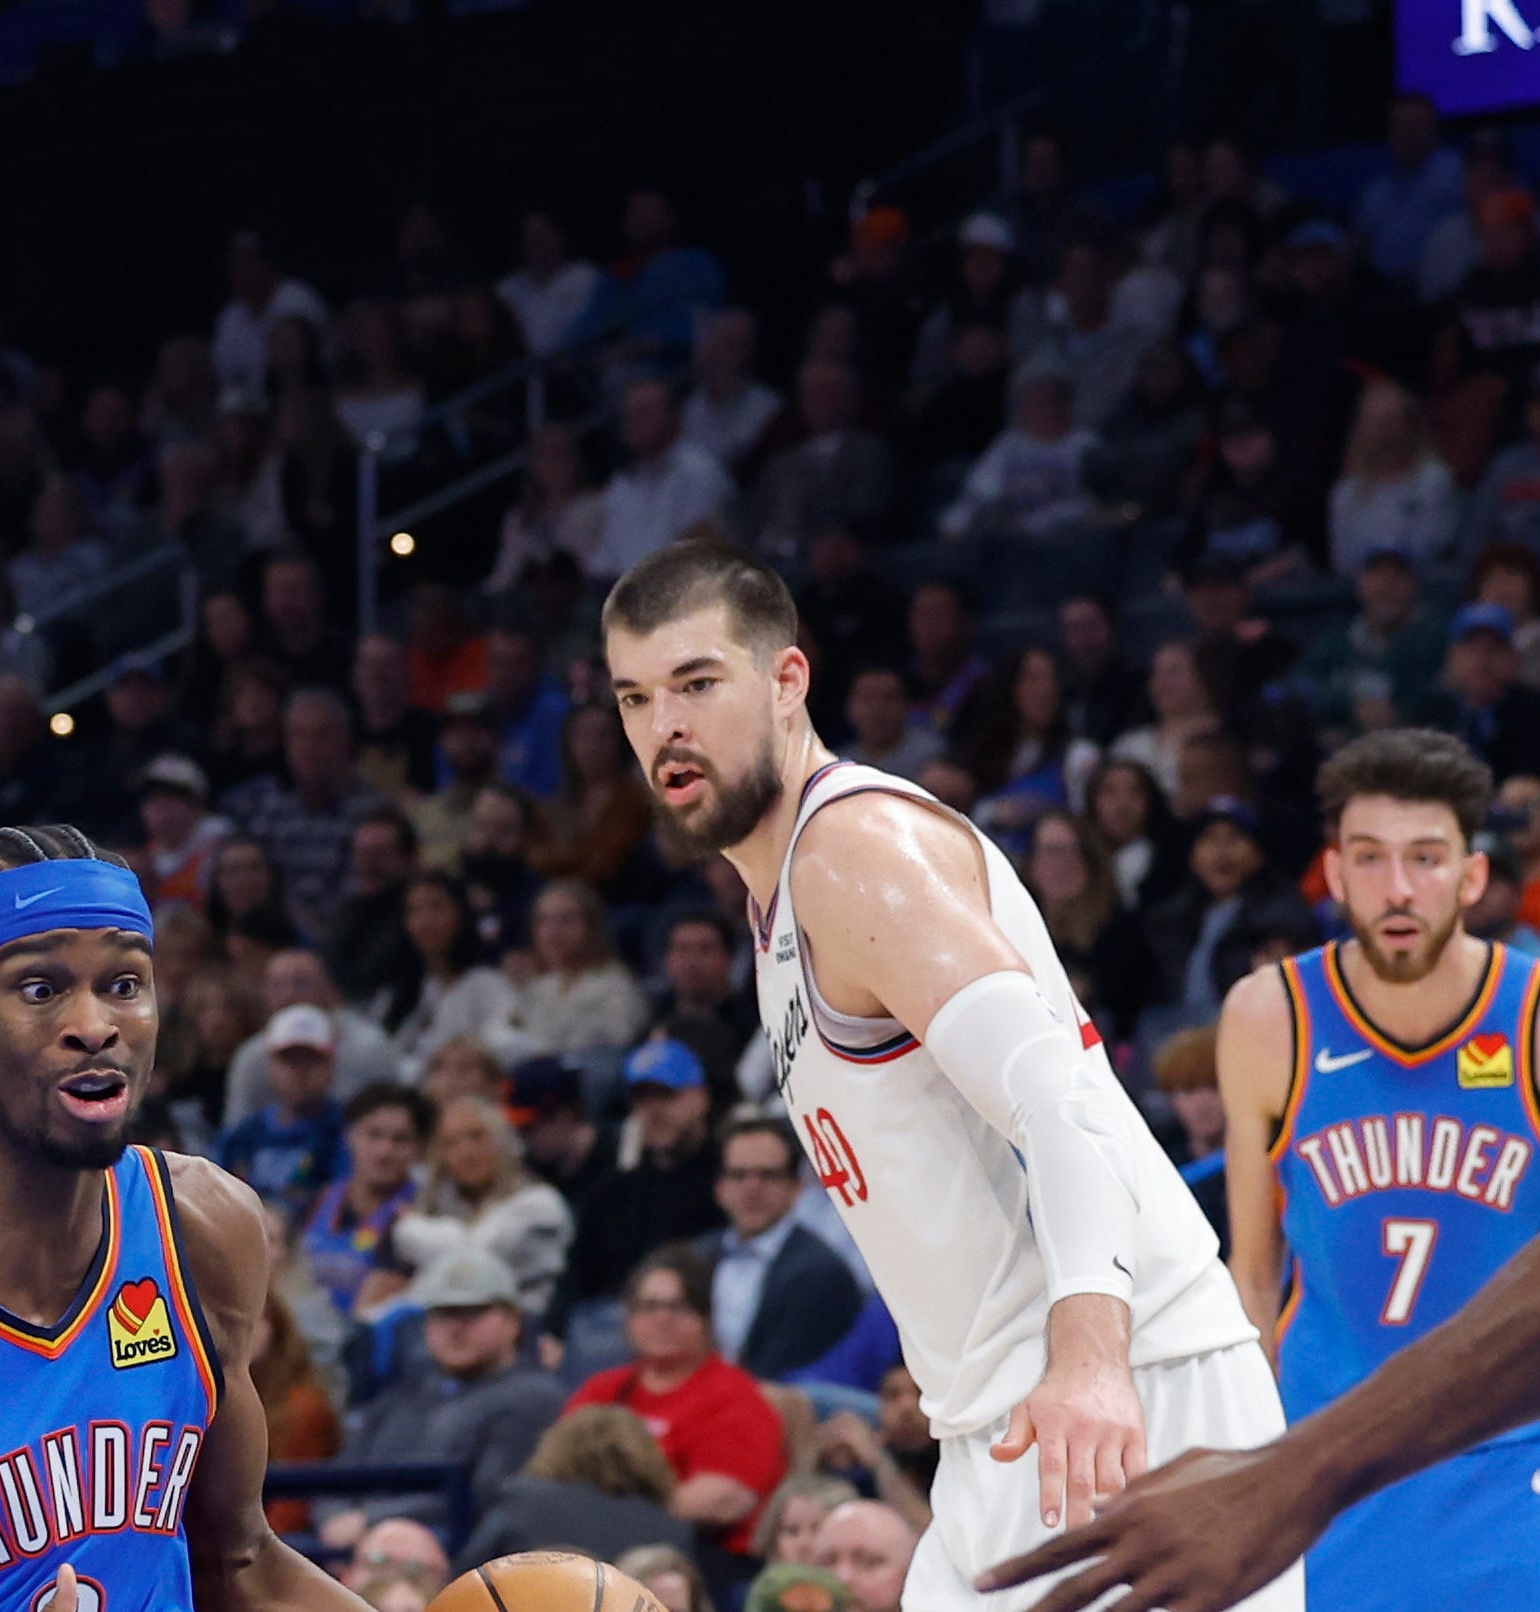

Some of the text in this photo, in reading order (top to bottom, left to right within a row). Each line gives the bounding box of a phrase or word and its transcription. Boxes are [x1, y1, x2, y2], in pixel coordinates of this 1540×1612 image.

[802, 1106, 868, 1207] 40
[1296, 1112, 1532, 1213] THUNDER
[1379, 1217, 1438, 1326] 7
